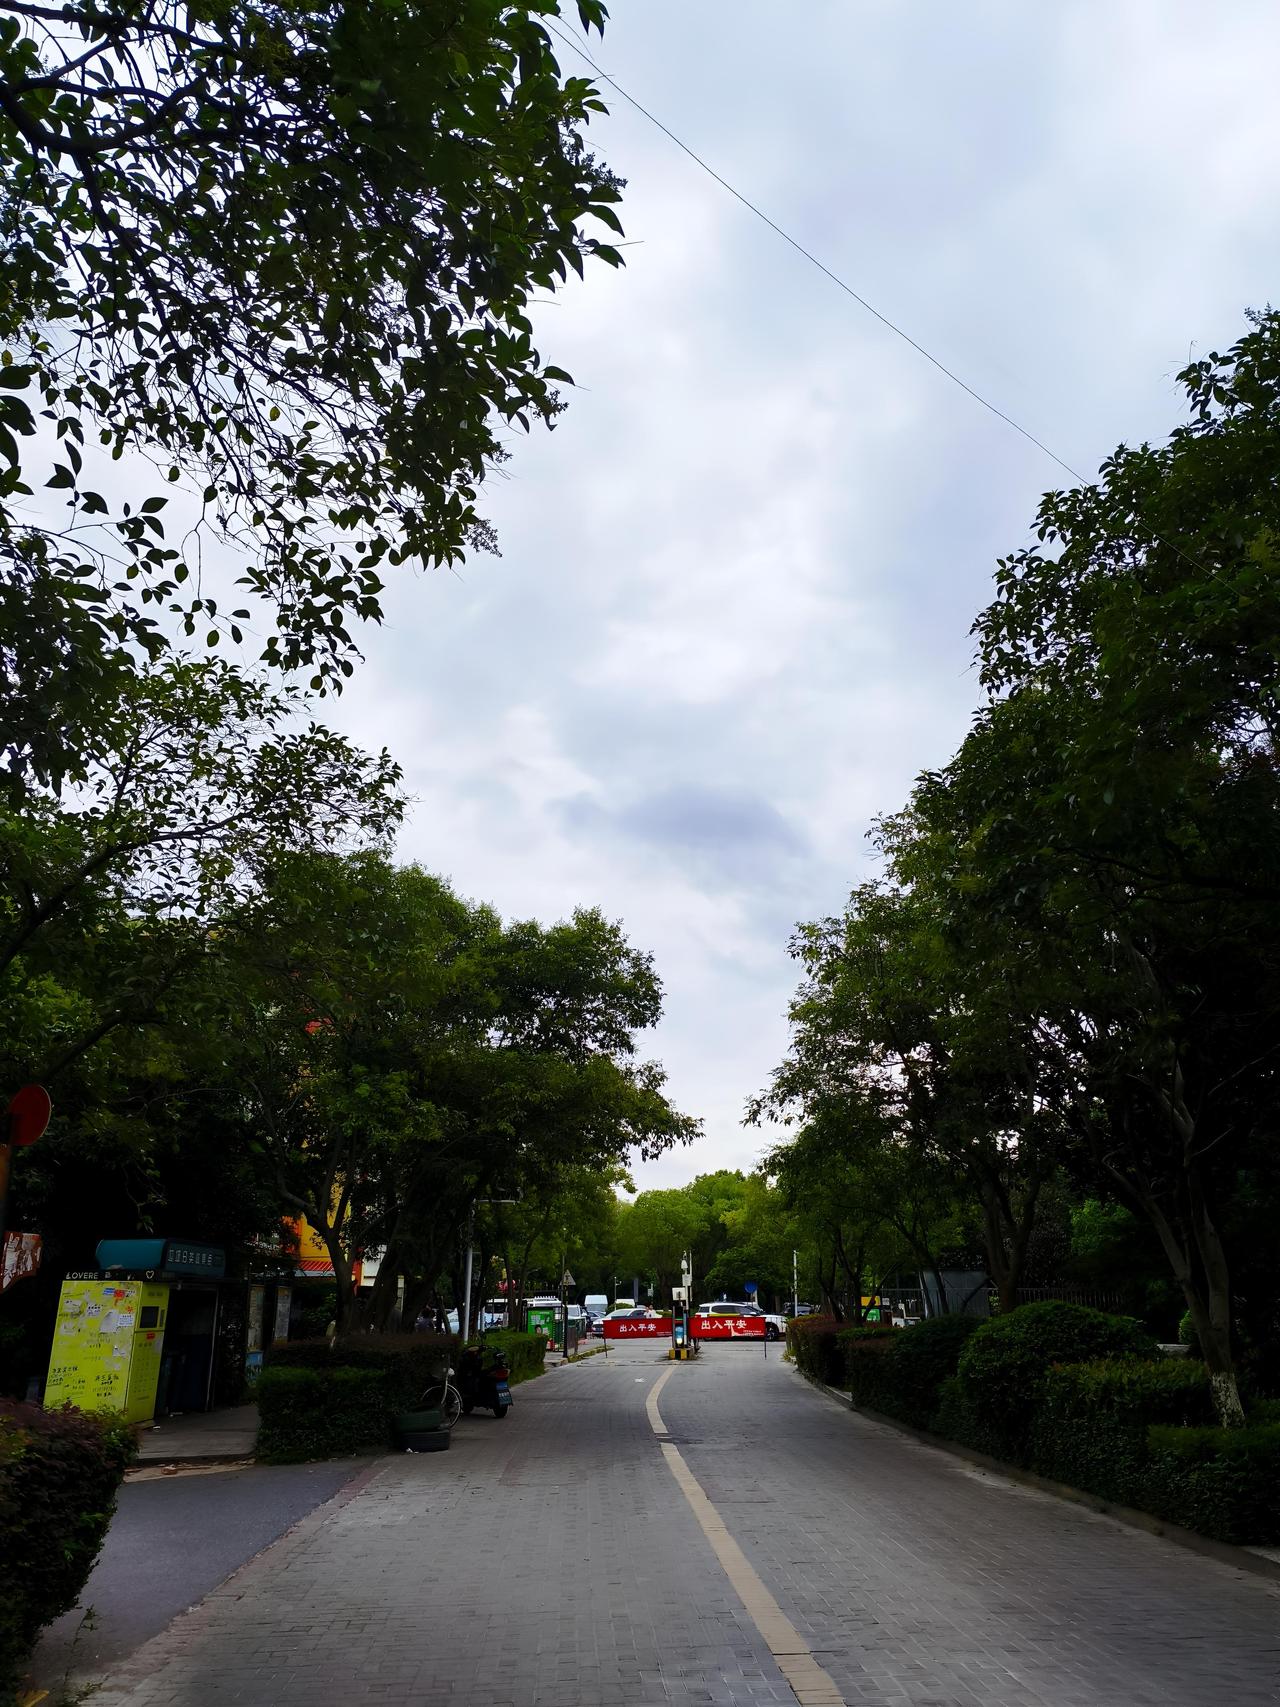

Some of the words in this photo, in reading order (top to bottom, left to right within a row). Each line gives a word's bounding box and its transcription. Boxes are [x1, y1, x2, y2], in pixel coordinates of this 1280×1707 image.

[619, 1323, 657, 1333] 出入平安
[701, 1319, 747, 1330] 出入平安
